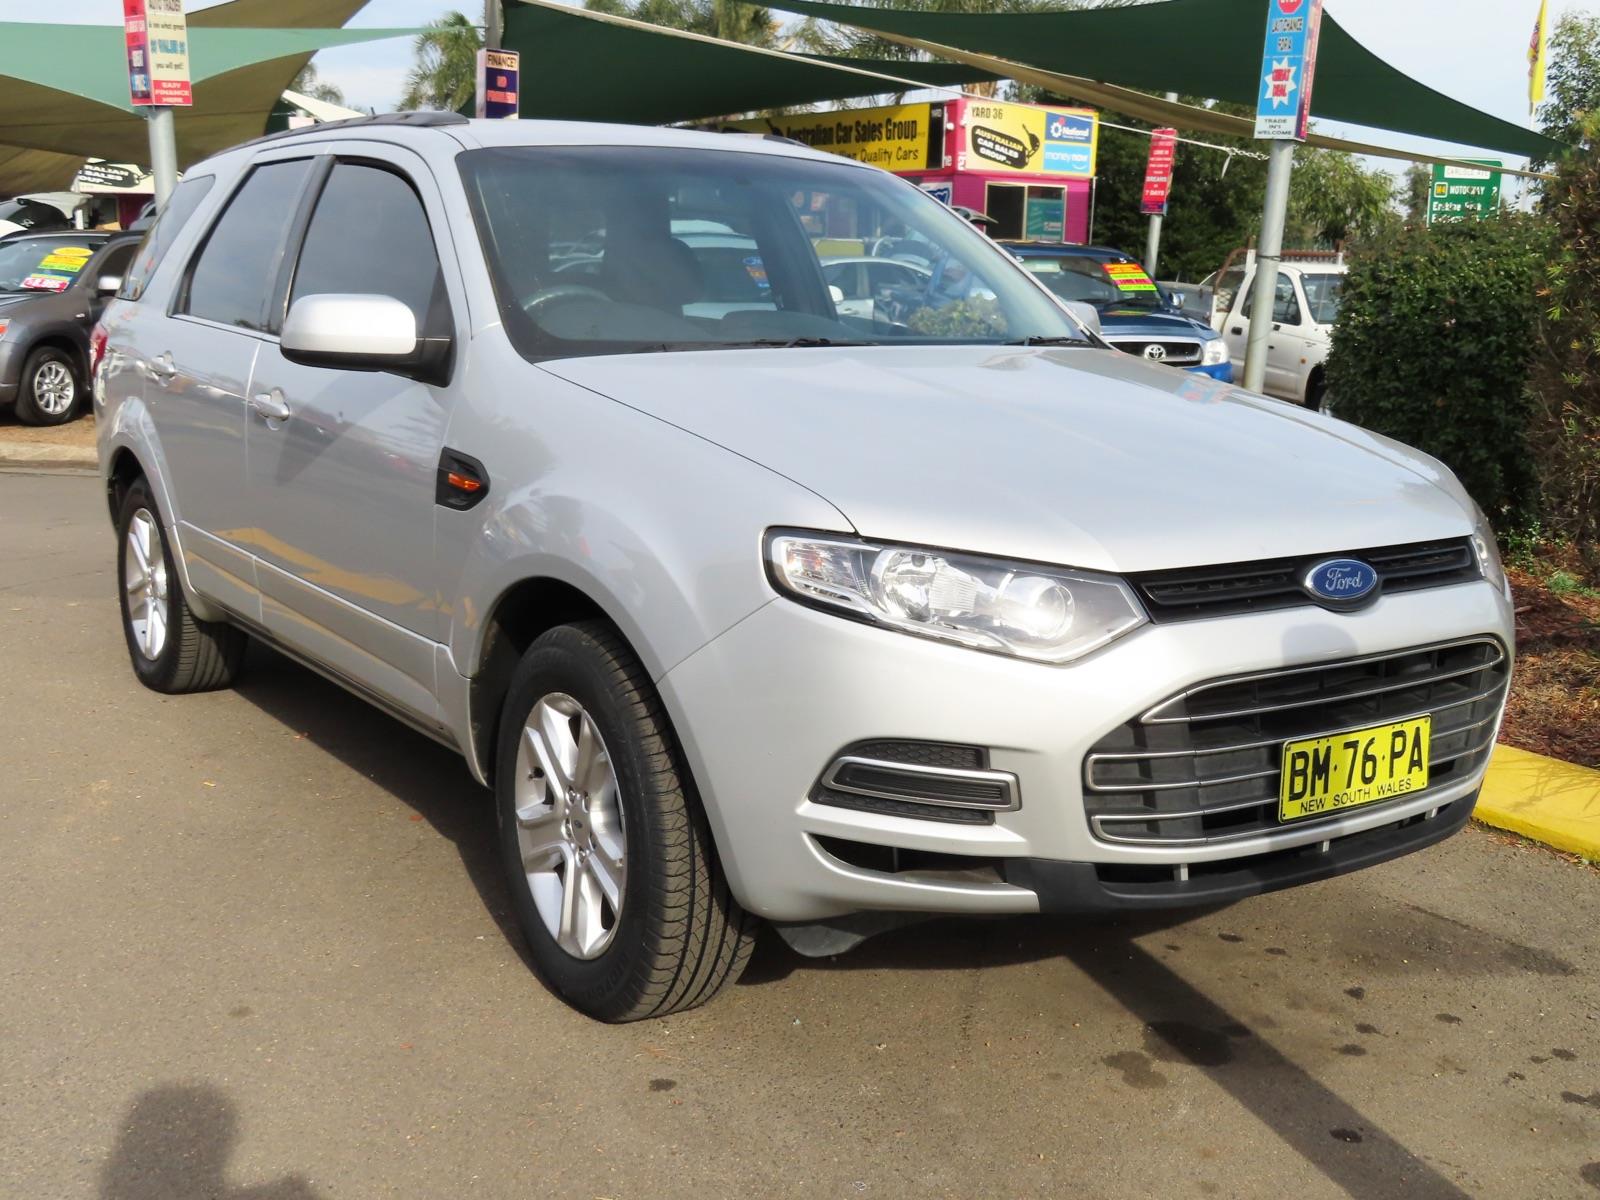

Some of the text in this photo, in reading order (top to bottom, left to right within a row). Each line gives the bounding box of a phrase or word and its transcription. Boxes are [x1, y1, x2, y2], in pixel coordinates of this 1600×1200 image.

[1285, 17, 1303, 31] CHANCE
[487, 54, 517, 68] FINANCE?
[971, 106, 1004, 120] YARD 36
[787, 117, 918, 147] Australian Car Sales Group
[975, 128, 1023, 152] AUSTRALIAN
[1062, 126, 1090, 137] National
[860, 148, 893, 166] Quality
[896, 146, 919, 161] Cars
[977, 137, 1019, 159] CAR SALES
[980, 147, 1007, 163] GROUP
[1044, 152, 1089, 164] money now
[1325, 567, 1362, 591] Ford
[1300, 778, 1412, 814] NEW SOUTH WALES
